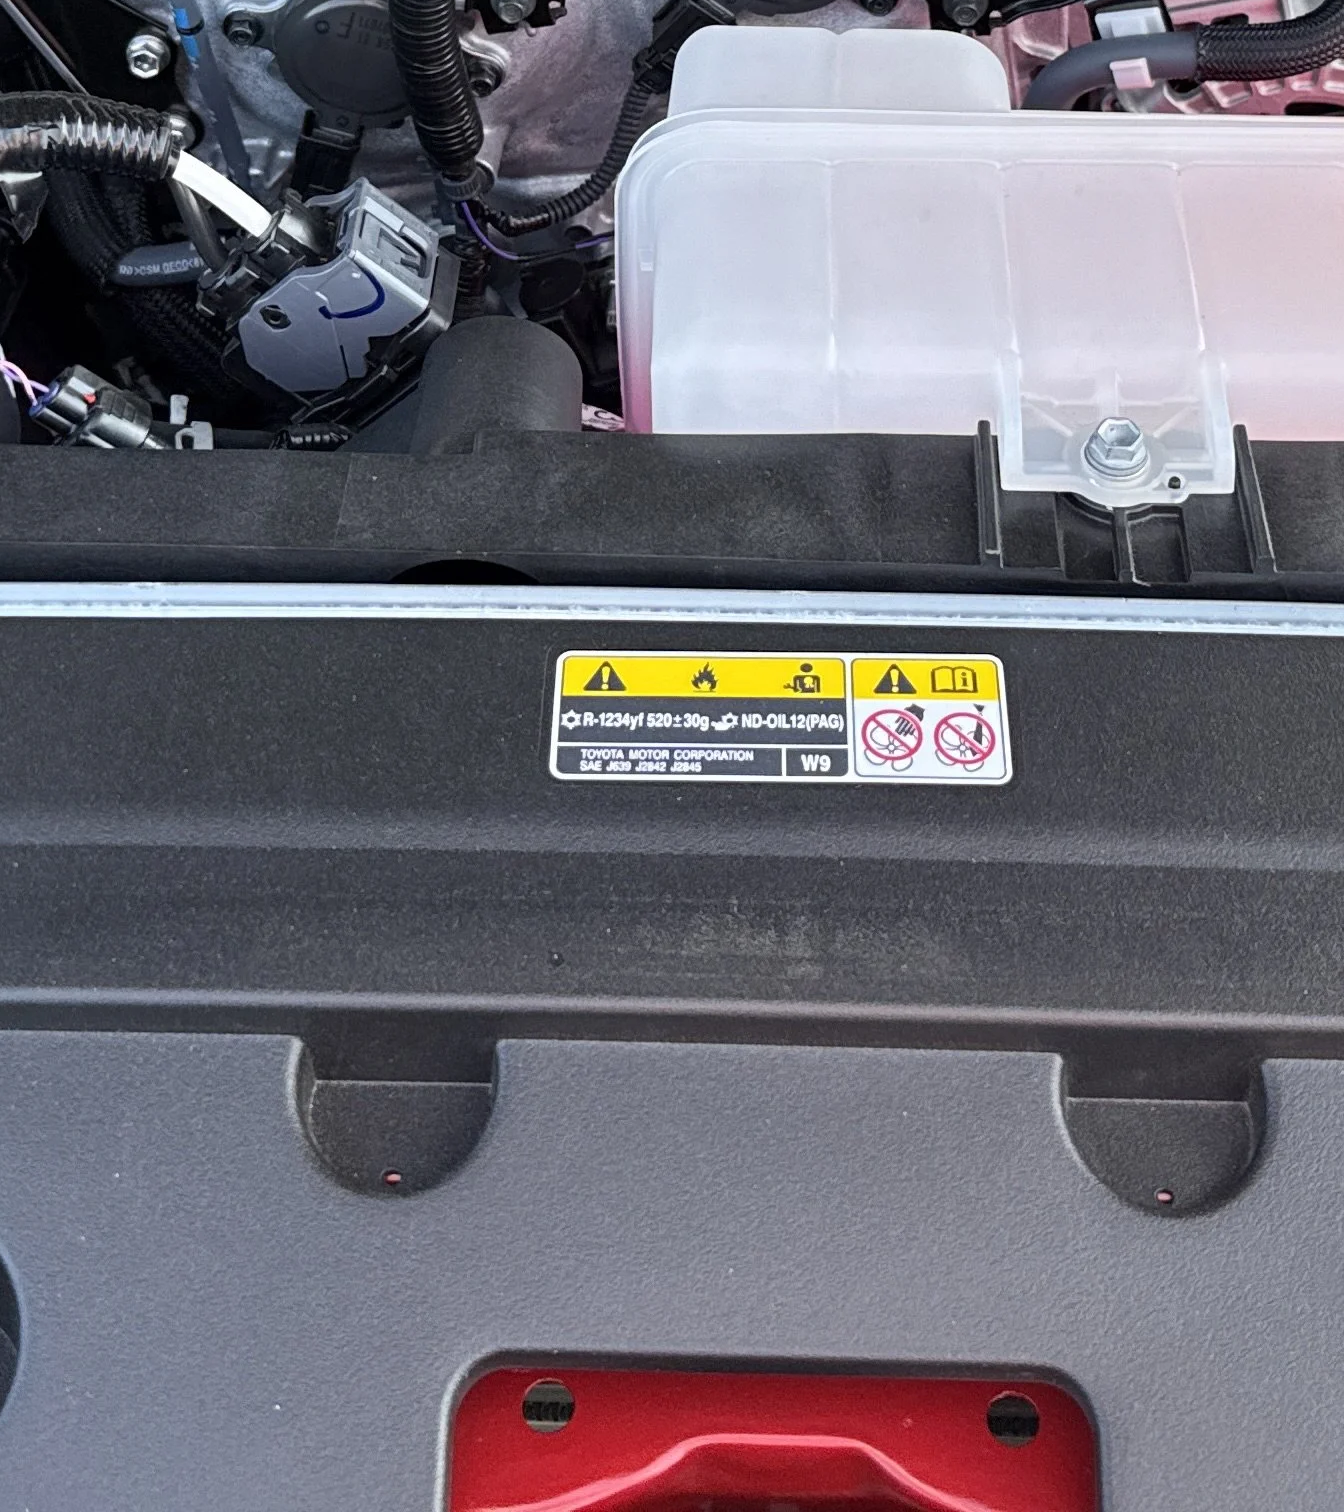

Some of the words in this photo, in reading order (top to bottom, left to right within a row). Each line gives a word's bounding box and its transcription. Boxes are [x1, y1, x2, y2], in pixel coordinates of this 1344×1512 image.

[583, 711, 645, 731] R-1234yf
[646, 711, 710, 732] 520±30g
[741, 713, 845, 732] ND-OIL12(PAG)
[580, 748, 625, 760] TOYOTA
[628, 749, 670, 761] MOTOR
[673, 749, 755, 762] CORPORATION
[800, 753, 832, 772] W9
[579, 760, 603, 772] SAE
[606, 760, 632, 772] J639
